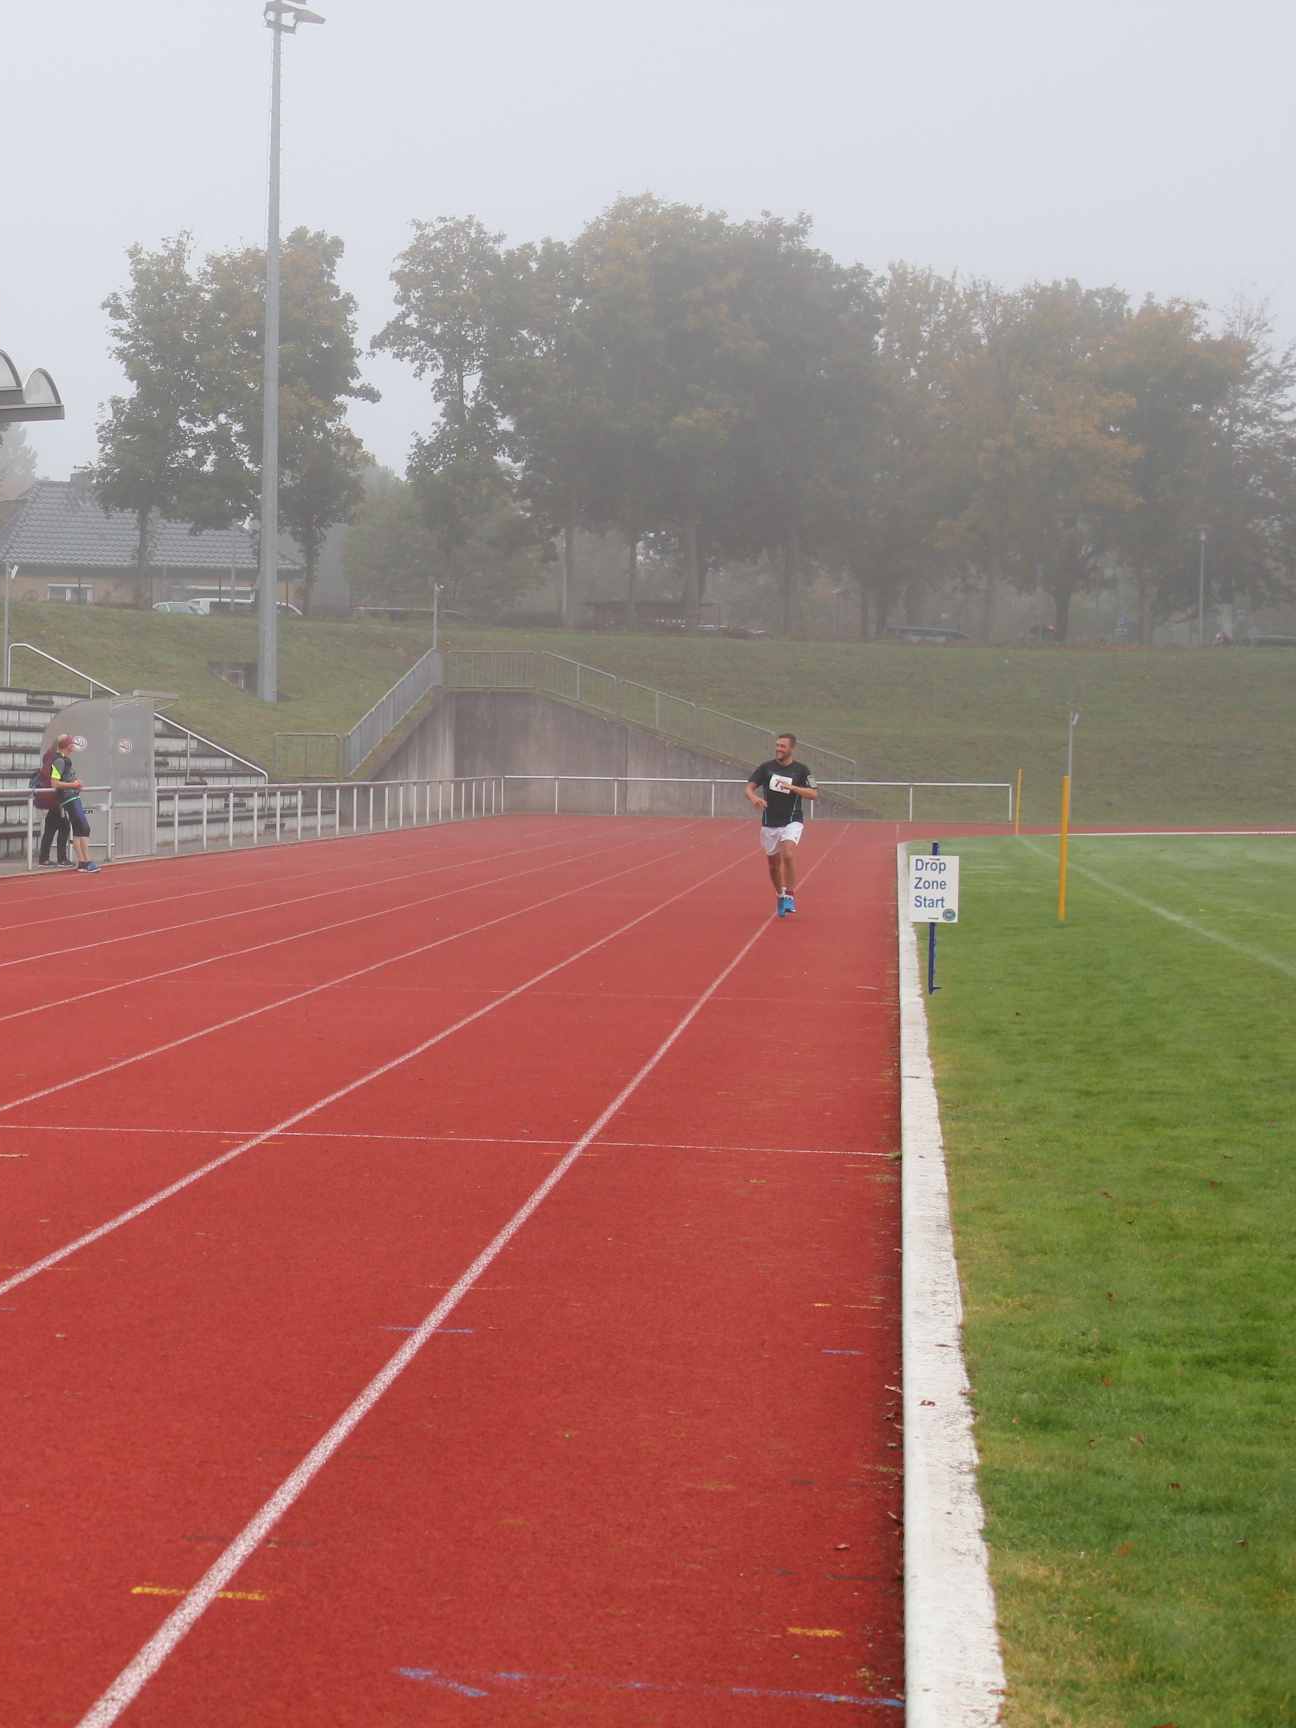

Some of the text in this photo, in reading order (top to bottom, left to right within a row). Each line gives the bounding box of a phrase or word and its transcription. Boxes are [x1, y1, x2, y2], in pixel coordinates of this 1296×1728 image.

[915, 858, 946, 874] Drop
[914, 876, 947, 890] Zone
[914, 895, 945, 909] Start
